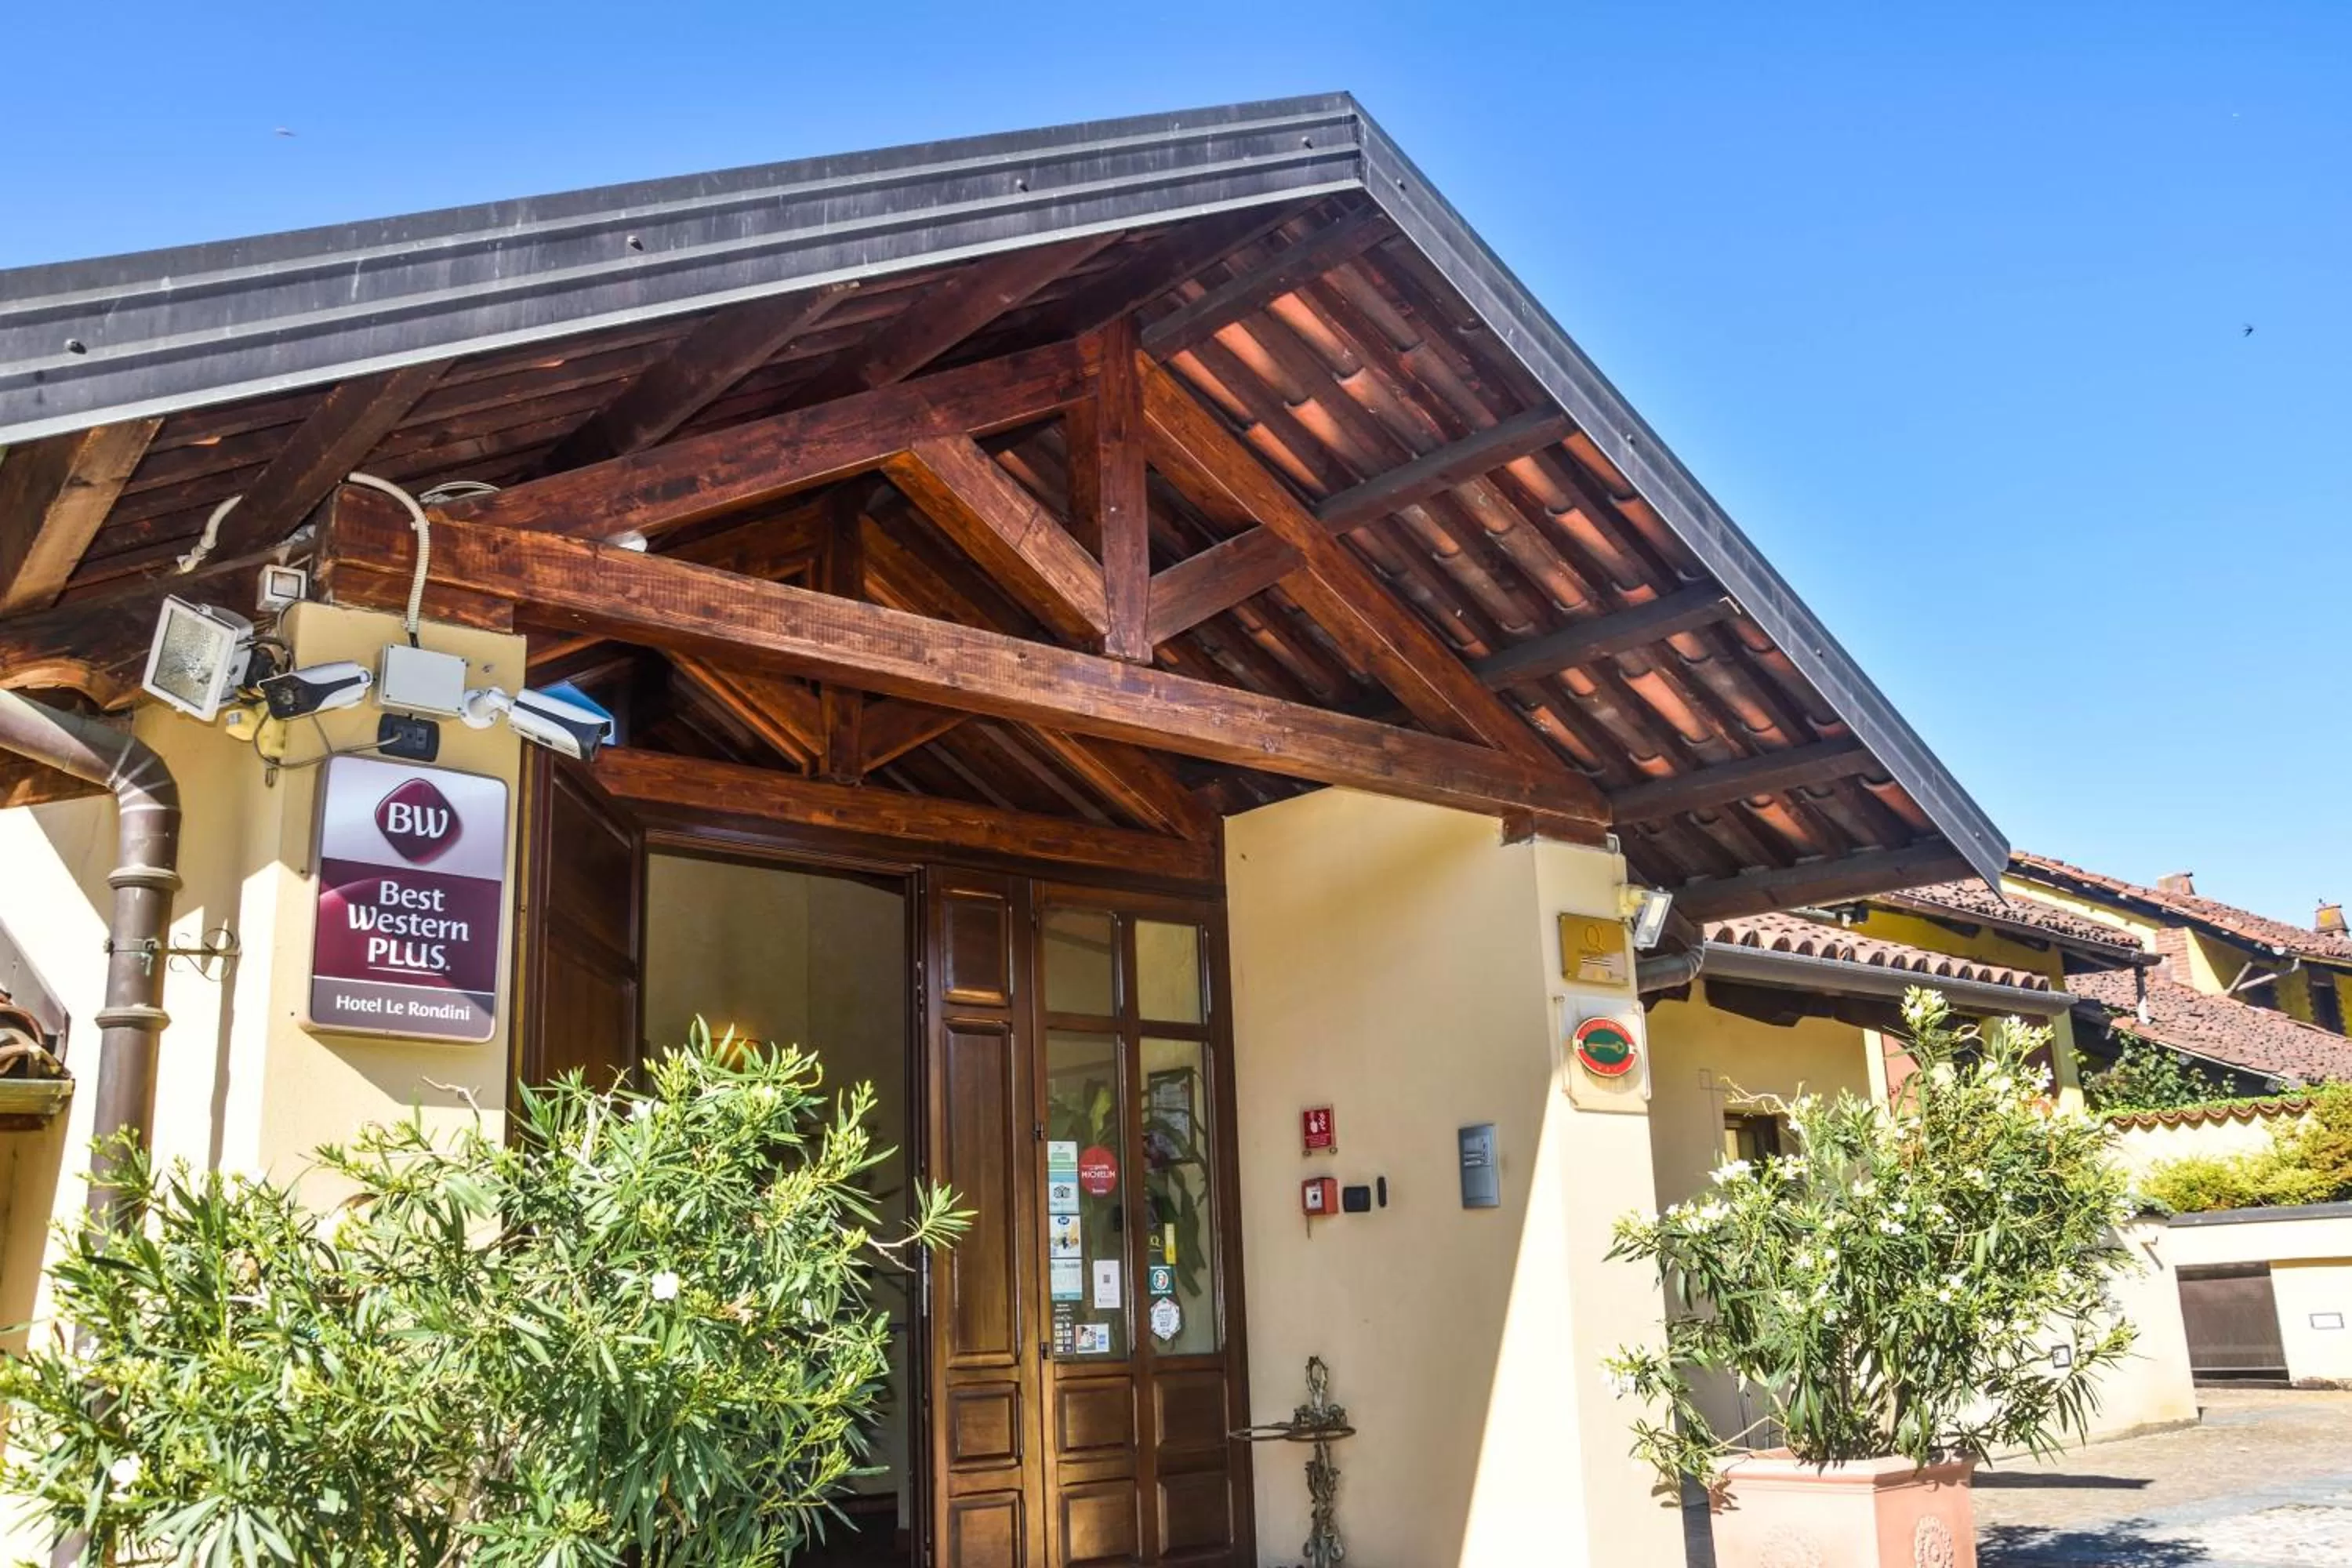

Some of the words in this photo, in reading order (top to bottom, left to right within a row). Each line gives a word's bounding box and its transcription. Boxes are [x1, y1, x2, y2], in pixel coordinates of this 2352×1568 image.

[387, 801, 448, 839] BW
[379, 880, 445, 912] Best
[347, 903, 470, 942] Western
[336, 994, 382, 1013] Hotel
[387, 1000, 405, 1015] Le
[408, 1000, 470, 1021] Rondini
[1081, 1171, 1116, 1179] MICHELIN
